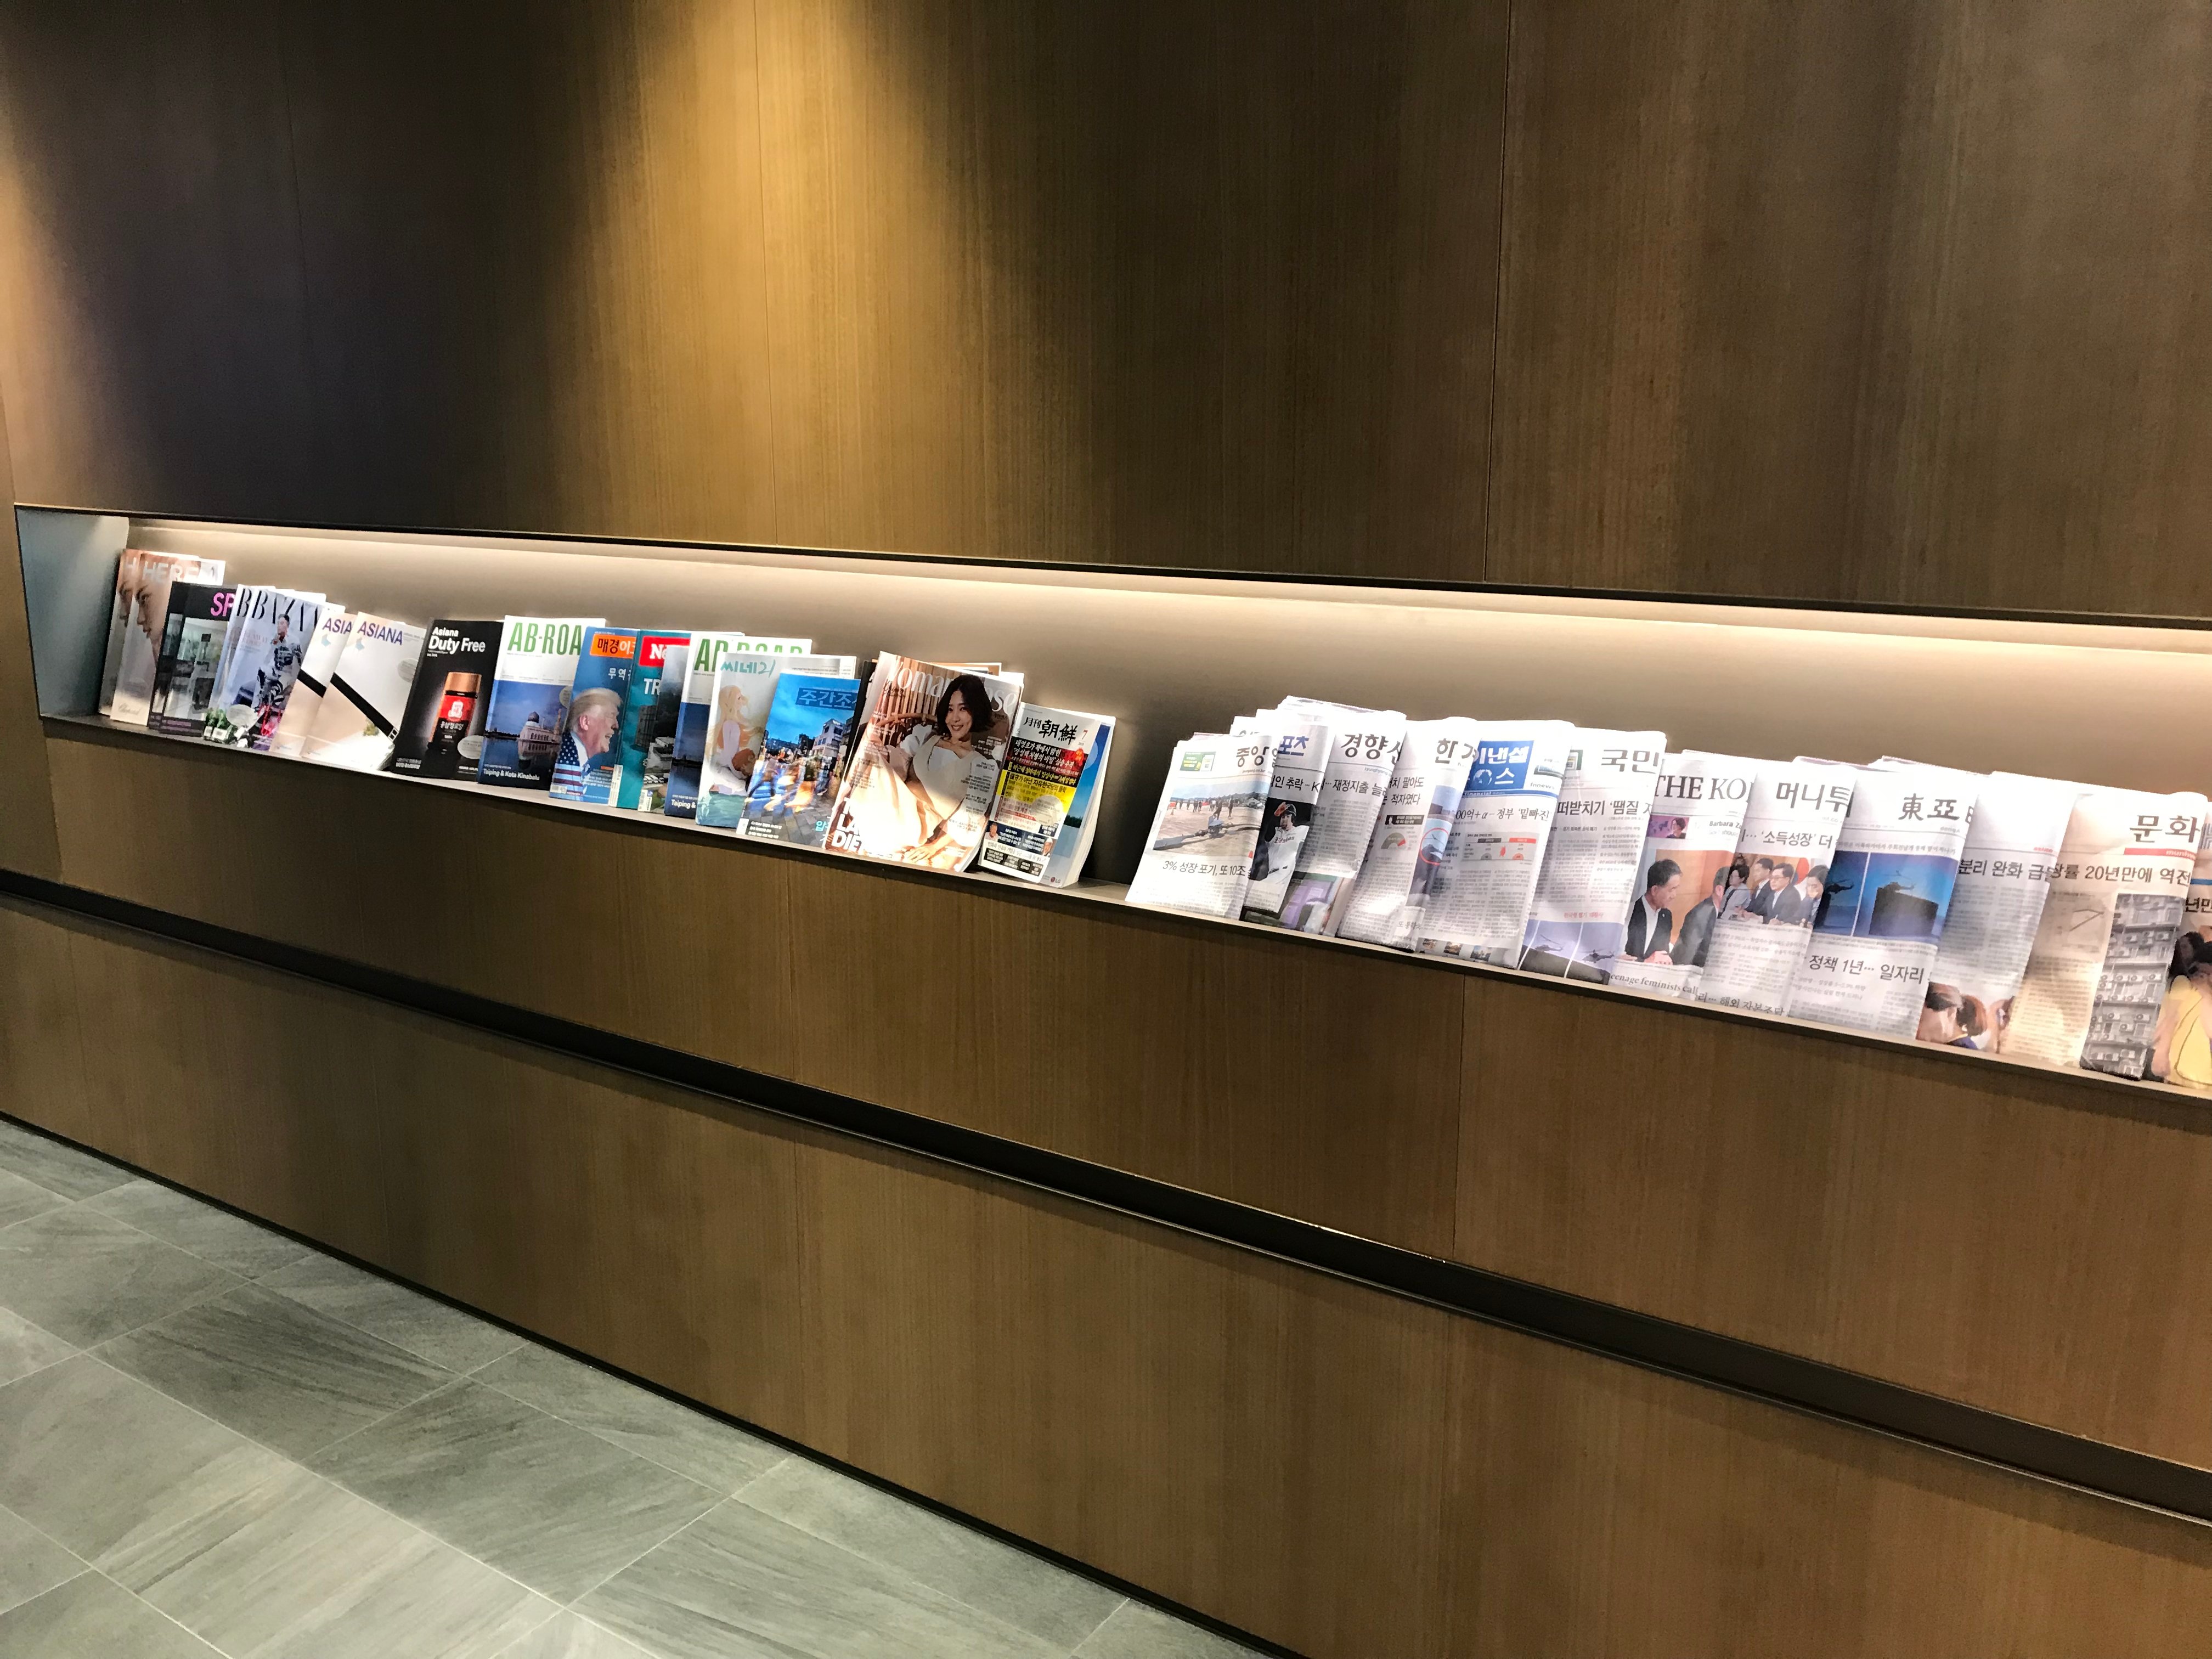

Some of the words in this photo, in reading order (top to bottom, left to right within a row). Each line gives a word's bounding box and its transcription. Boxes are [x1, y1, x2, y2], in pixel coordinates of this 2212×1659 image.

[357, 621, 404, 645] ASIANA
[432, 627, 459, 637] Asiana
[428, 635, 460, 654] Duty
[461, 637, 486, 652] Free
[608, 667, 631, 680] 무역
[720, 659, 776, 678] 씨네21
[799, 689, 857, 709] 주간조
[1024, 716, 1042, 729] 月刊
[1039, 719, 1078, 745] 朝鮮
[1082, 729, 1088, 740] 7
[1601, 749, 1660, 775] 국민
[1333, 779, 1369, 794] 재정지출
[1402, 776, 1425, 789] 팔아도
[1654, 775, 1704, 800] THE
[671, 799, 691, 809] Taiping
[1391, 793, 1421, 805] 적자였다
[1776, 782, 1850, 812] 머니투
[1497, 808, 1514, 820] 정부
[1557, 800, 1605, 816] 떠받치기
[2129, 815, 2201, 843] 문화
[1819, 834, 1833, 849] 더
[1163, 860, 1177, 871] 3%
[1180, 862, 1198, 873] 성장
[1198, 864, 1217, 877] 포기,
[1219, 865, 1228, 876] 또
[1229, 865, 1246, 876] 10조
[1958, 859, 1988, 876] 분리
[1992, 860, 2023, 879] 완화
[2084, 865, 2153, 883] 20년만에
[2159, 868, 2191, 888] 역전
[1809, 954, 1839, 972] 정책
[1880, 963, 1925, 985] 일자리
[1640, 977, 1680, 992] feminists
[1720, 996, 1740, 1008] 해외
